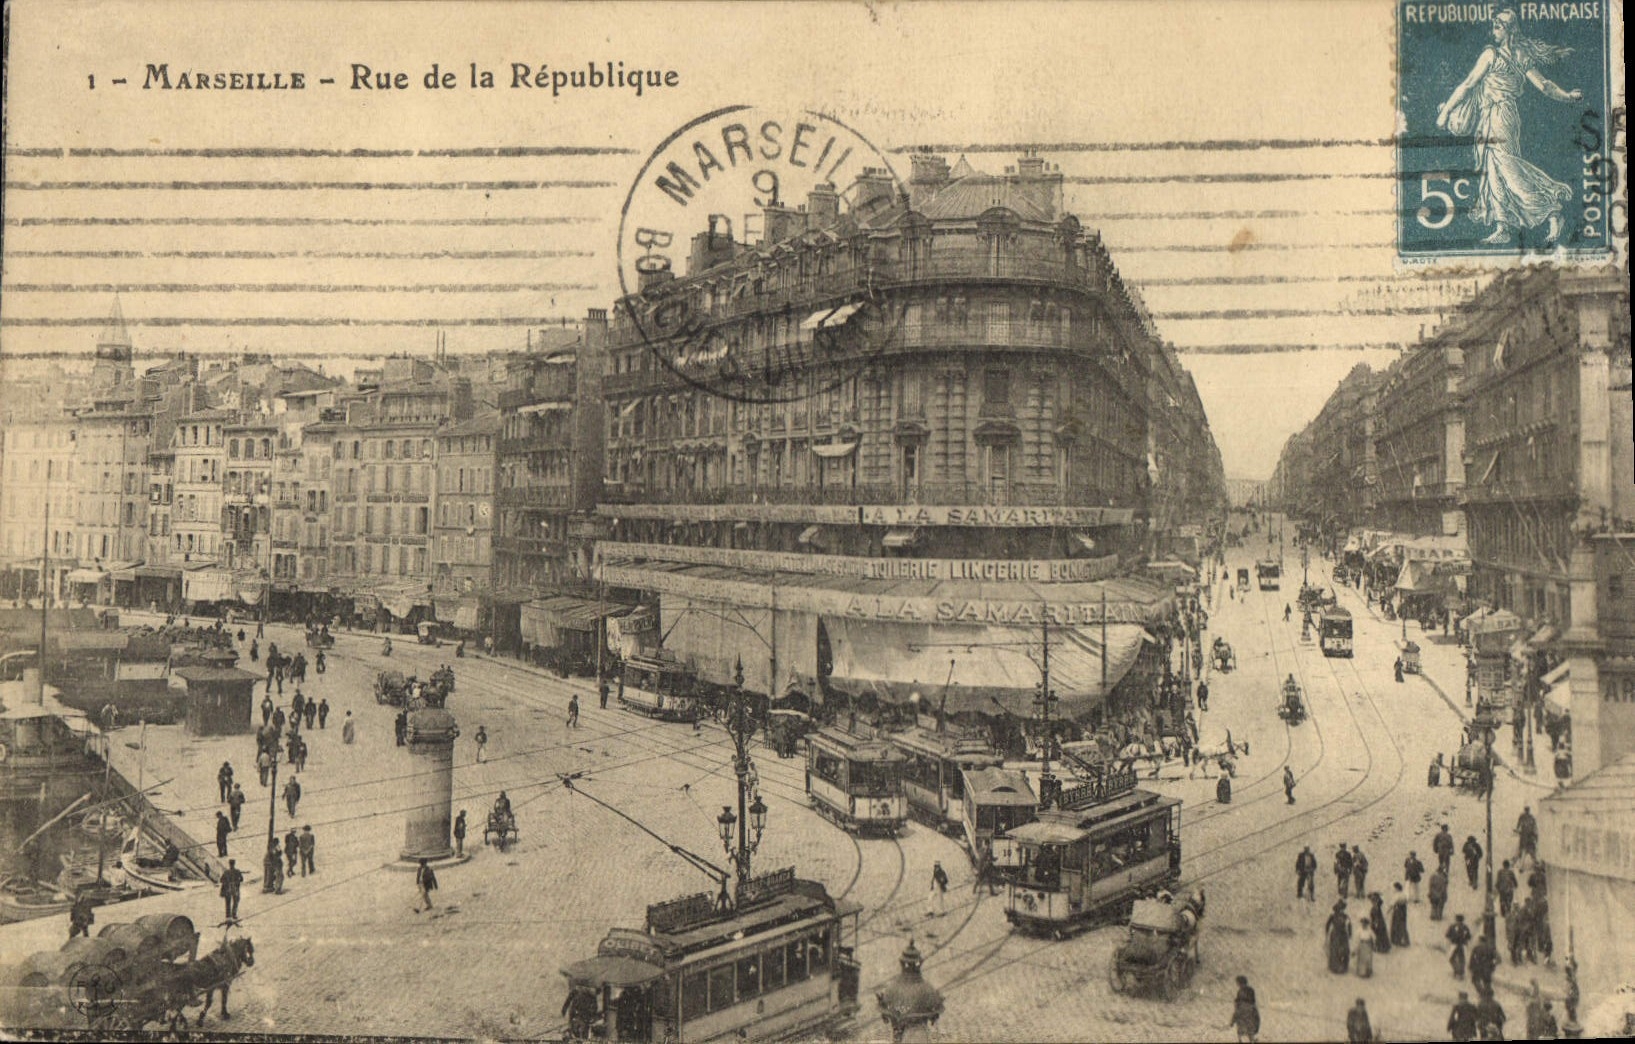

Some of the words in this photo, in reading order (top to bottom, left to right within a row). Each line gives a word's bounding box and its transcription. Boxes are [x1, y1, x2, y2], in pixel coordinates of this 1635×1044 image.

[1405, 3, 1496, 24] REPUBLIQUE
[1520, 1, 1600, 22] FRANÇAISE
[1582, 152, 1603, 239] POSTES
[949, 559, 1040, 581] LINGERIE
[845, 596, 868, 618] A
[875, 598, 922, 621] LA
